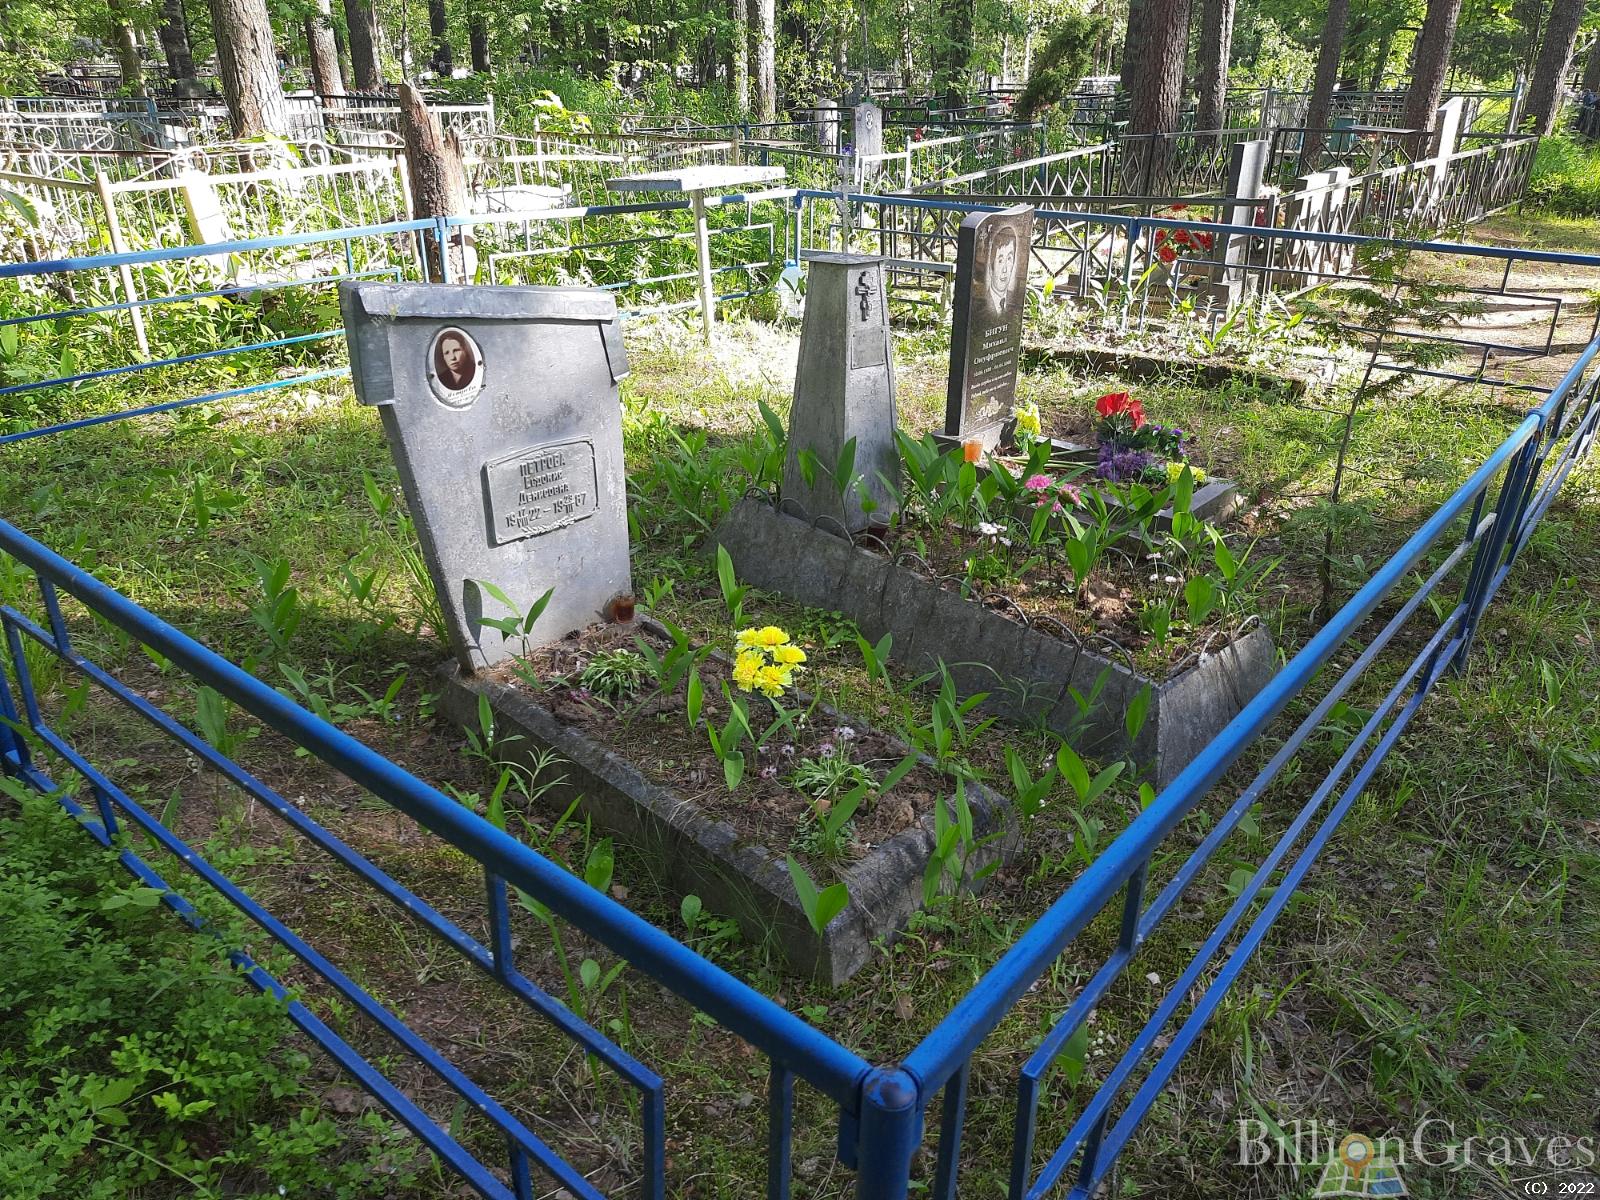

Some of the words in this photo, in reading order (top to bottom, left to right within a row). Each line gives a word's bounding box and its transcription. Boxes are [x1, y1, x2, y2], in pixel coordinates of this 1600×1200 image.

[984, 323, 1009, 338] БИГУН
[519, 453, 566, 477] ПЕТРОВА
[518, 483, 569, 506] Денисовна
